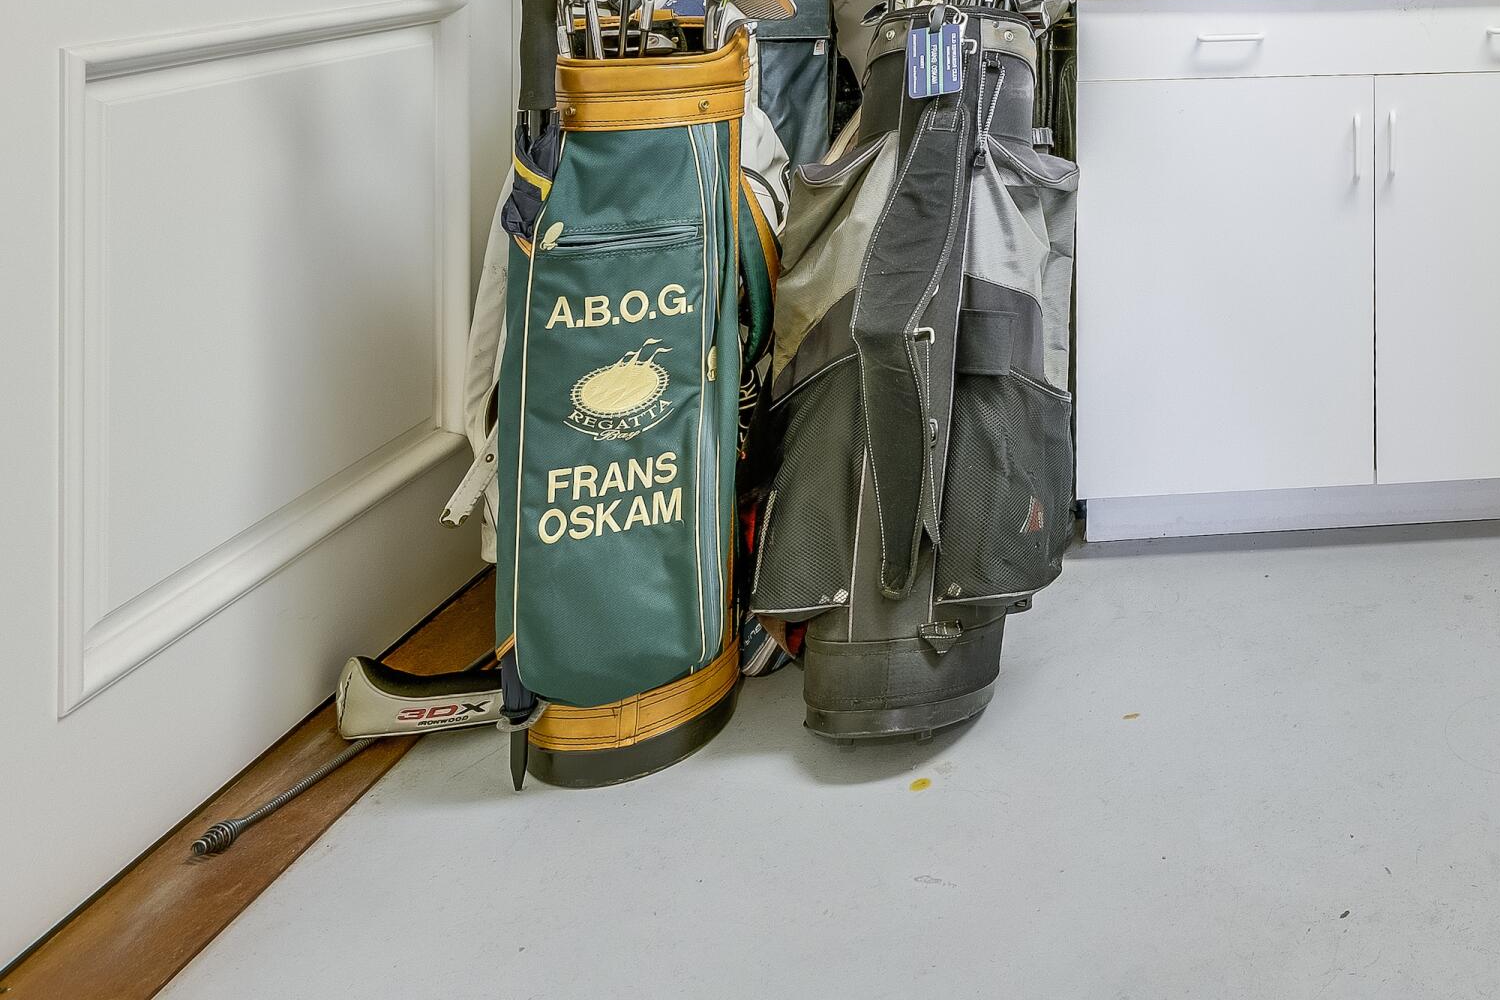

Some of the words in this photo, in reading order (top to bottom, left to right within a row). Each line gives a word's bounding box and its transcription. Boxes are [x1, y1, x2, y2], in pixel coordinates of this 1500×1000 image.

[545, 283, 694, 330] A.B.O.G.
[568, 399, 673, 431] REGATTA
[594, 428, 641, 441] Bay
[547, 451, 678, 504] FRANS
[538, 487, 683, 545] OSKAM
[398, 700, 492, 721] 3DX
[418, 715, 469, 726] IRONWOOD
